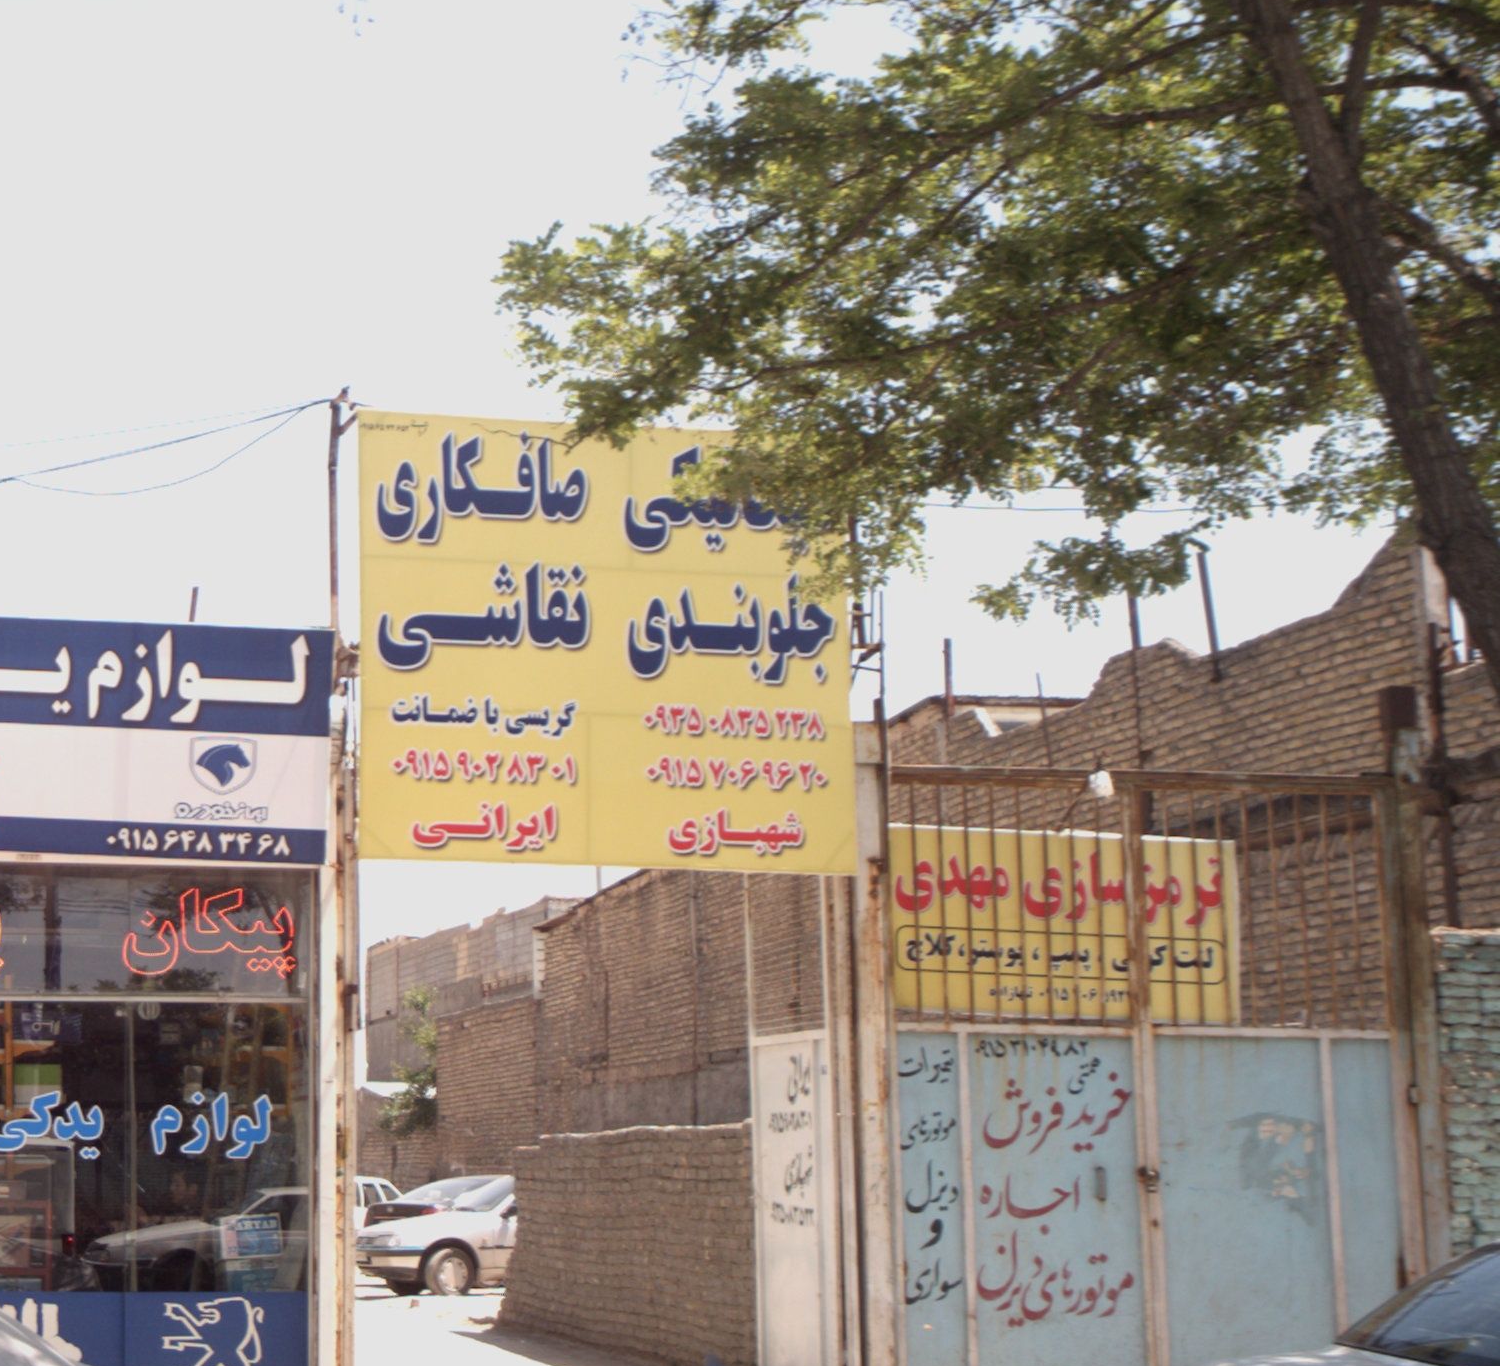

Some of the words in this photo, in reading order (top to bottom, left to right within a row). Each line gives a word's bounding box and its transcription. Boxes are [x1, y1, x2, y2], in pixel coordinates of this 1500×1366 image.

[377, 431, 590, 543] صافکاری
[376, 560, 594, 671] نقاشی
[627, 572, 837, 685] جلوبندی
[88, 628, 311, 724] لوازم
[390, 694, 480, 724] ضمانت
[483, 696, 501, 733] با
[411, 803, 559, 851] ایرانی
[667, 808, 805, 857] شهبازی
[894, 855, 1010, 912] مهدی
[121, 886, 298, 980] پیکان
[898, 1046, 954, 1084] تعمیرات
[151, 1091, 273, 1160] لوازم
[900, 1111, 957, 1151] موتورهای
[983, 1078, 1065, 1156] فروش
[1066, 1071, 1133, 1153] خرید
[905, 1158, 960, 1214] دیزل
[979, 1174, 1081, 1236] اجاره
[920, 1218, 944, 1250] و
[904, 1258, 963, 1306] سواری
[976, 1229, 1045, 1328] دیزل
[1020, 1252, 1136, 1321] موتورهای
